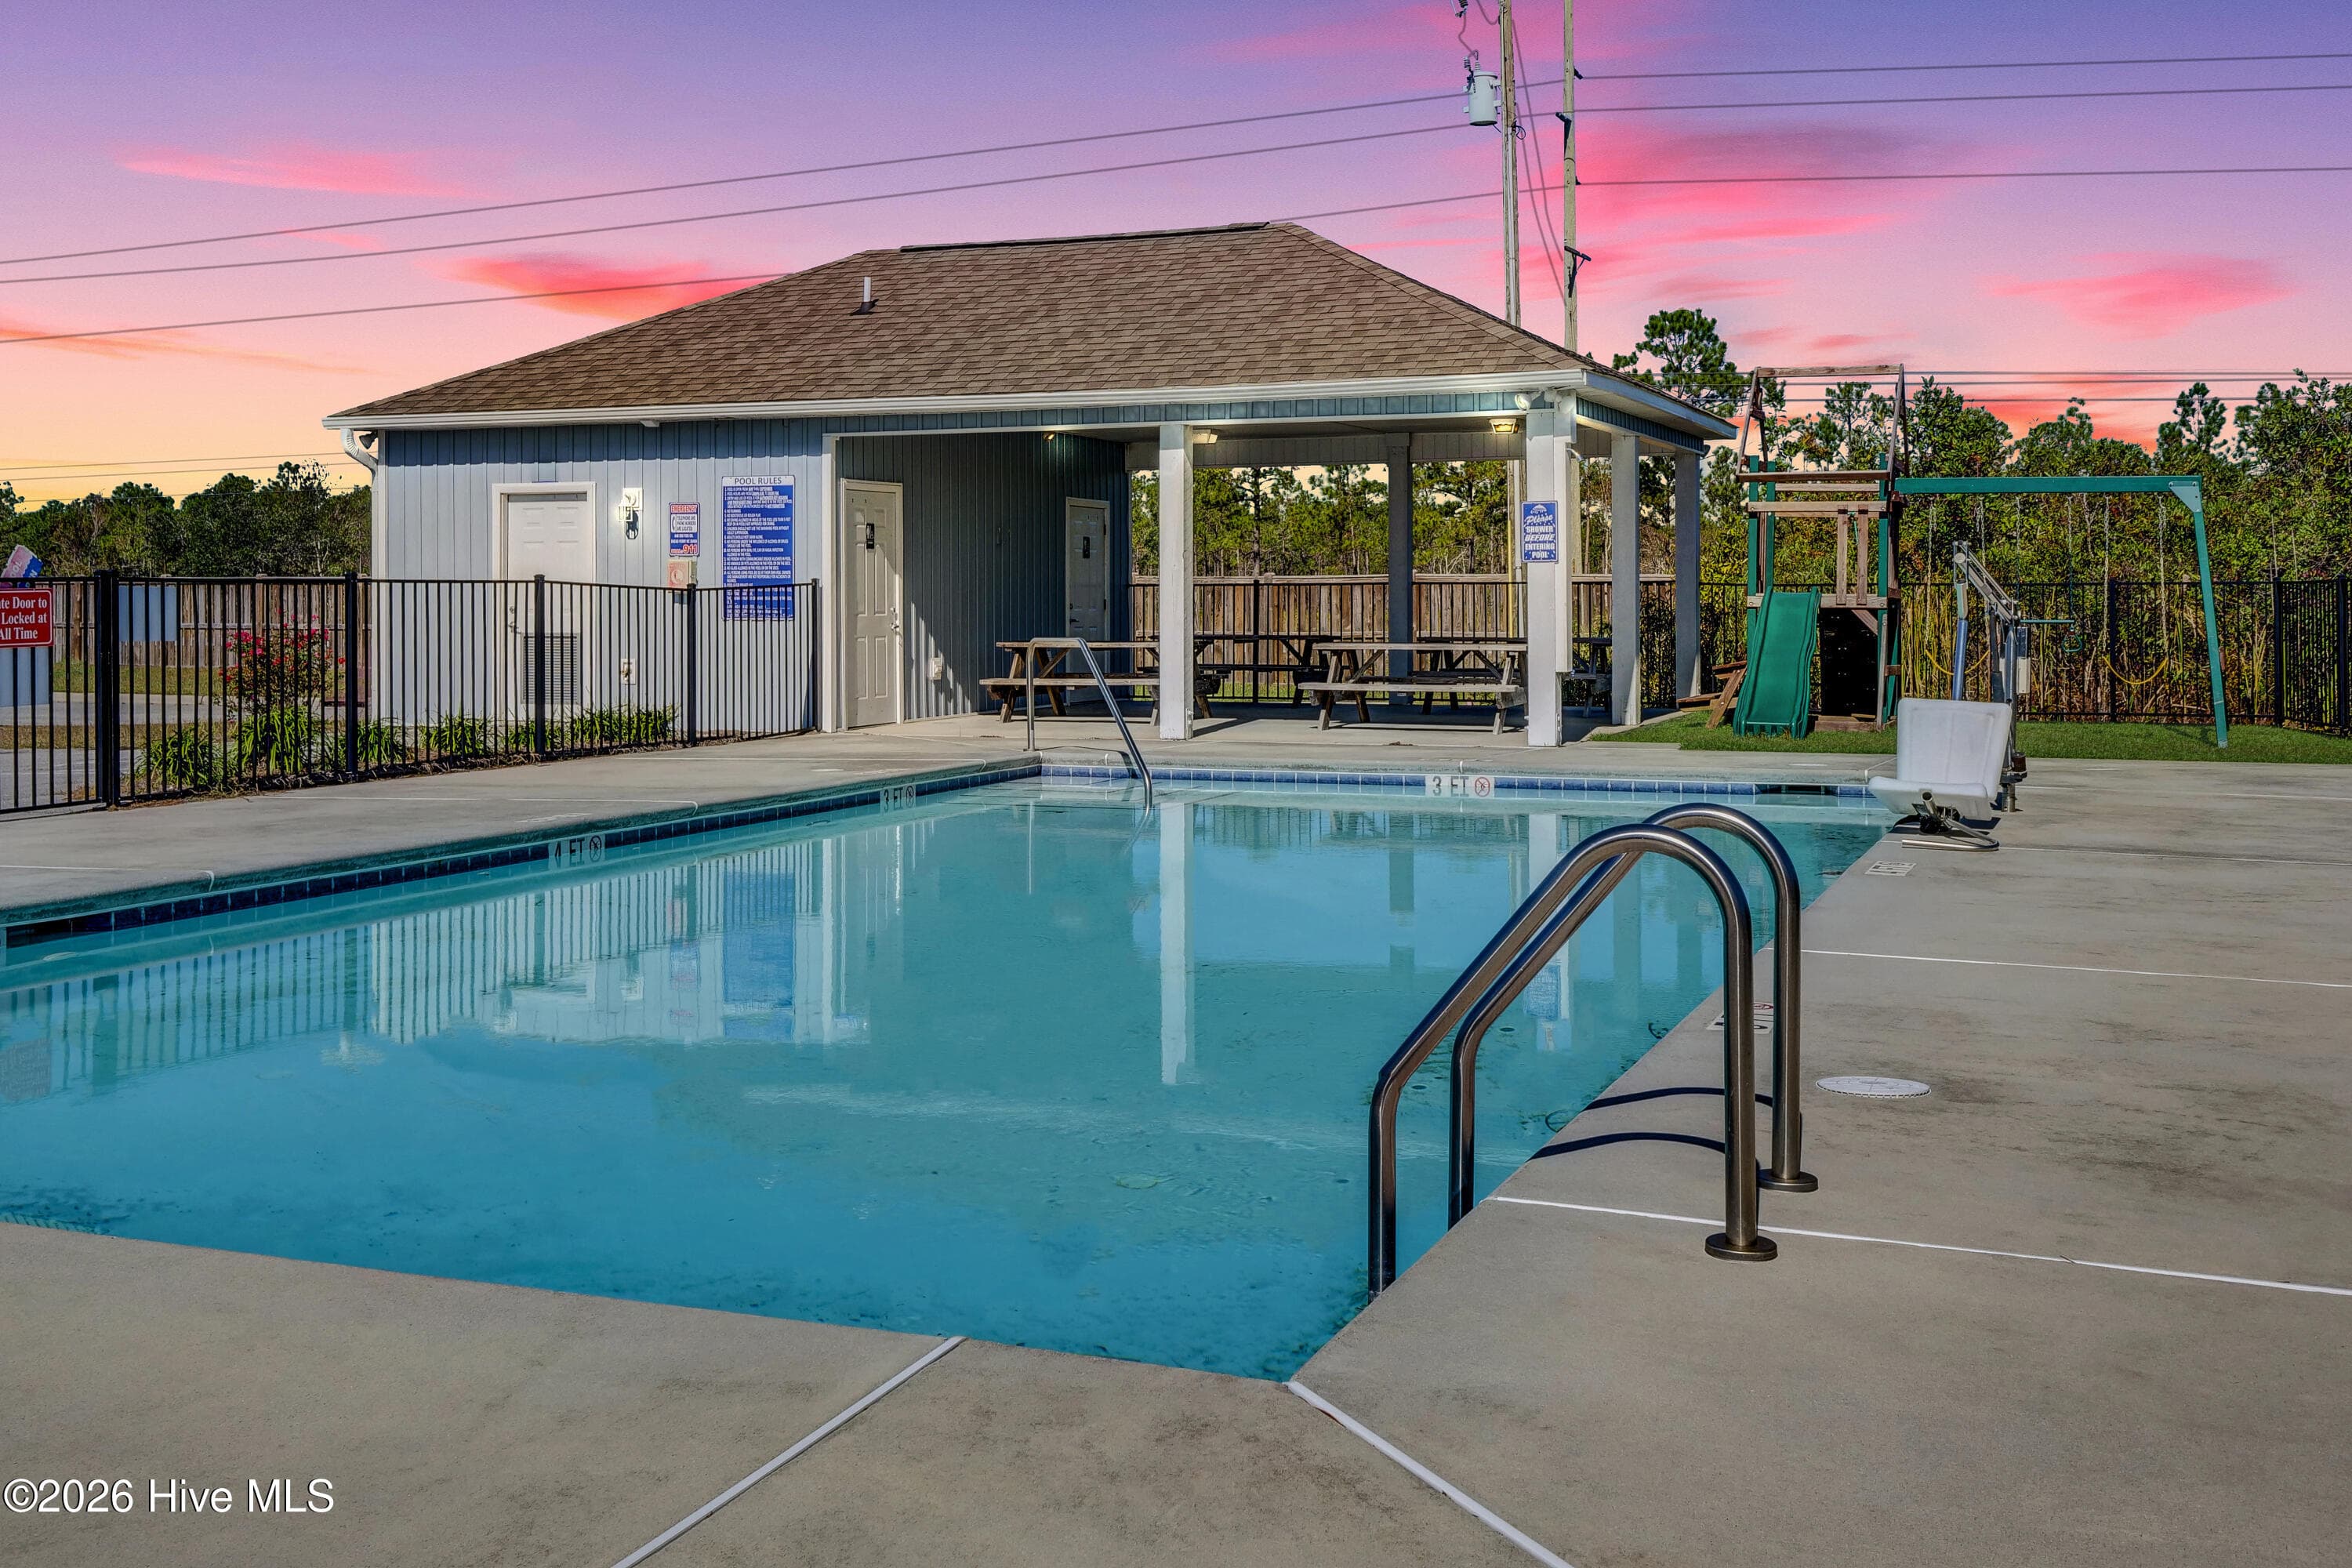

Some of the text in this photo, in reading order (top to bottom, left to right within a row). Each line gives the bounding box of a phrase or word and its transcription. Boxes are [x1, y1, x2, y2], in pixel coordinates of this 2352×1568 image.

[1524, 514, 1553, 524] Please
[683, 544, 697, 554] 911
[13, 597, 36, 609] Door
[38, 597, 48, 608] to
[2, 612, 48, 625] Locked at
[0, 626, 38, 640] All Time
